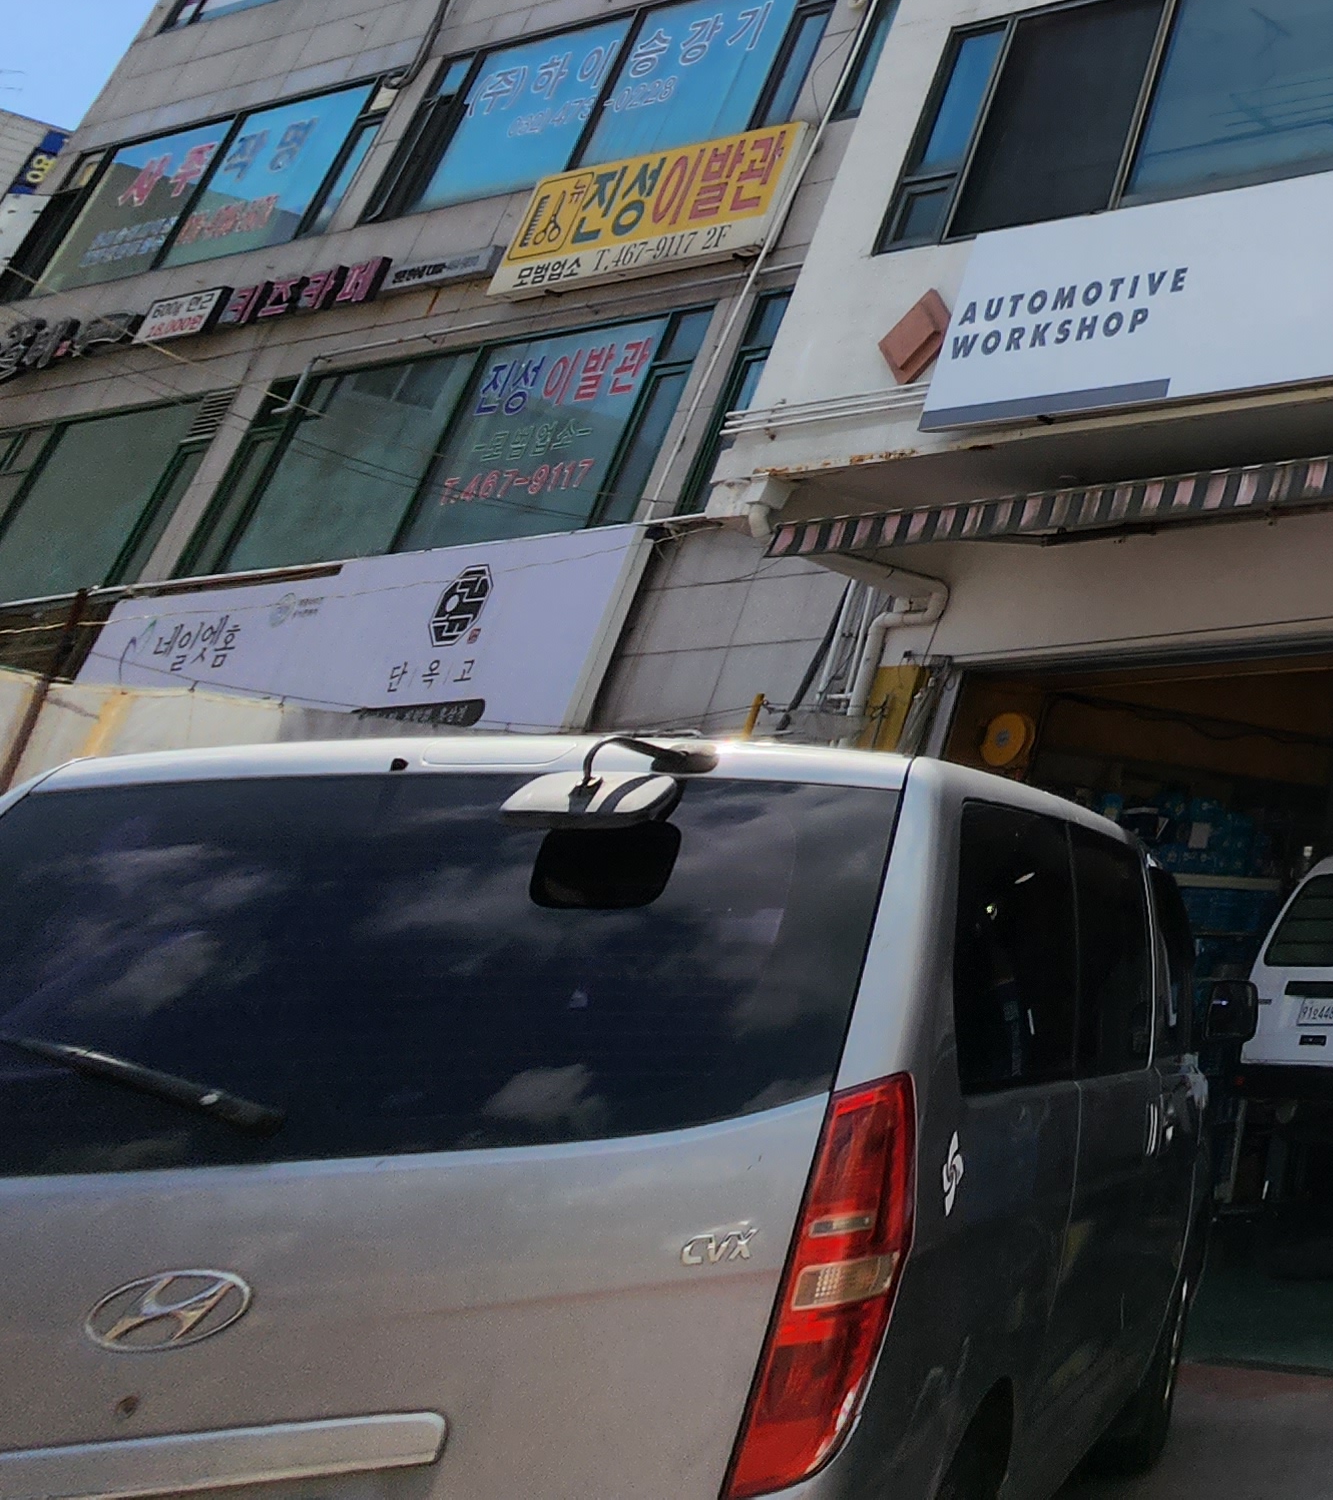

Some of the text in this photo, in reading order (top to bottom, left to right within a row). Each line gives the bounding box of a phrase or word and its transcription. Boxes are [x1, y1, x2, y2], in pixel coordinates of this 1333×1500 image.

[513, 256, 581, 288] 모범업소
[592, 231, 697, 273] T.467-9117
[702, 224, 731, 249] 2F
[957, 267, 1189, 327] AUTOMOTIVE
[949, 307, 1150, 361] WORKSHOP
[679, 1224, 760, 1268] CVX
